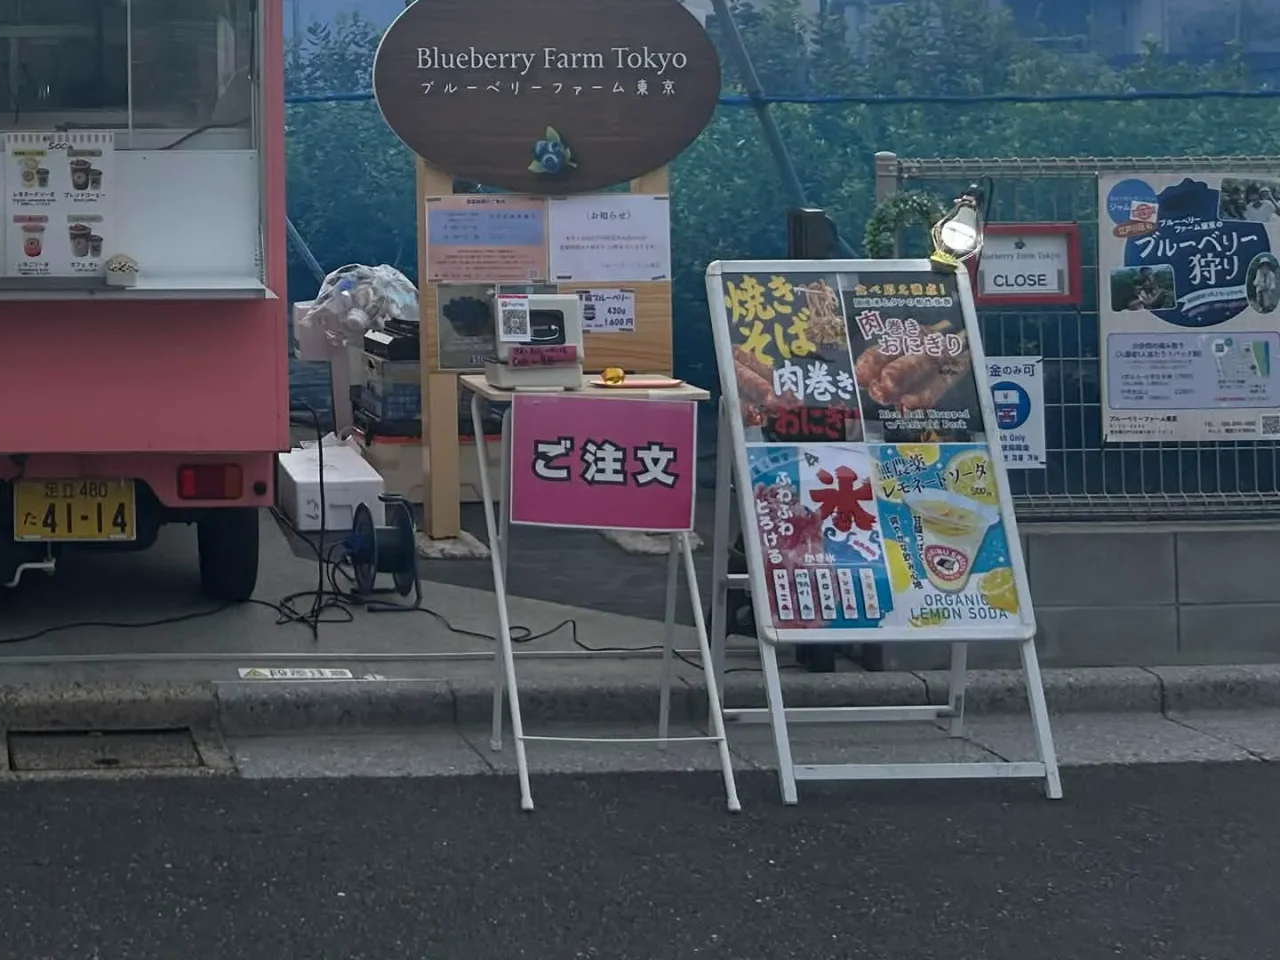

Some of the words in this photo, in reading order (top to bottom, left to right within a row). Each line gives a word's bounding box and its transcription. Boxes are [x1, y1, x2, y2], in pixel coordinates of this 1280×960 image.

[416, 46, 536, 75] Blueberry
[543, 46, 604, 69] Farm
[610, 46, 688, 75] Tokyo
[420, 79, 677, 97] ブルーベリーファーム東京
[1134, 231, 1258, 259] ブルーベリー
[993, 274, 1048, 287] CLOSE
[1188, 252, 1239, 285] 狩り
[724, 274, 795, 323] 焼き
[739, 307, 817, 368] そば
[855, 310, 921, 340] 肉巻き
[878, 333, 963, 356] おにぎり
[773, 359, 854, 402] 肉巻き
[986, 363, 1036, 377] 金のみ可
[532, 436, 679, 489] ご注文
[776, 471, 794, 536] ふわふわ
[809, 465, 878, 532] 氷
[23, 511, 37, 526] た
[42, 503, 127, 533] 41-14
[756, 499, 783, 564] とろける
[910, 607, 962, 620] LEMON
[969, 607, 1008, 620] SODA
[924, 594, 989, 607] ORGANIC
